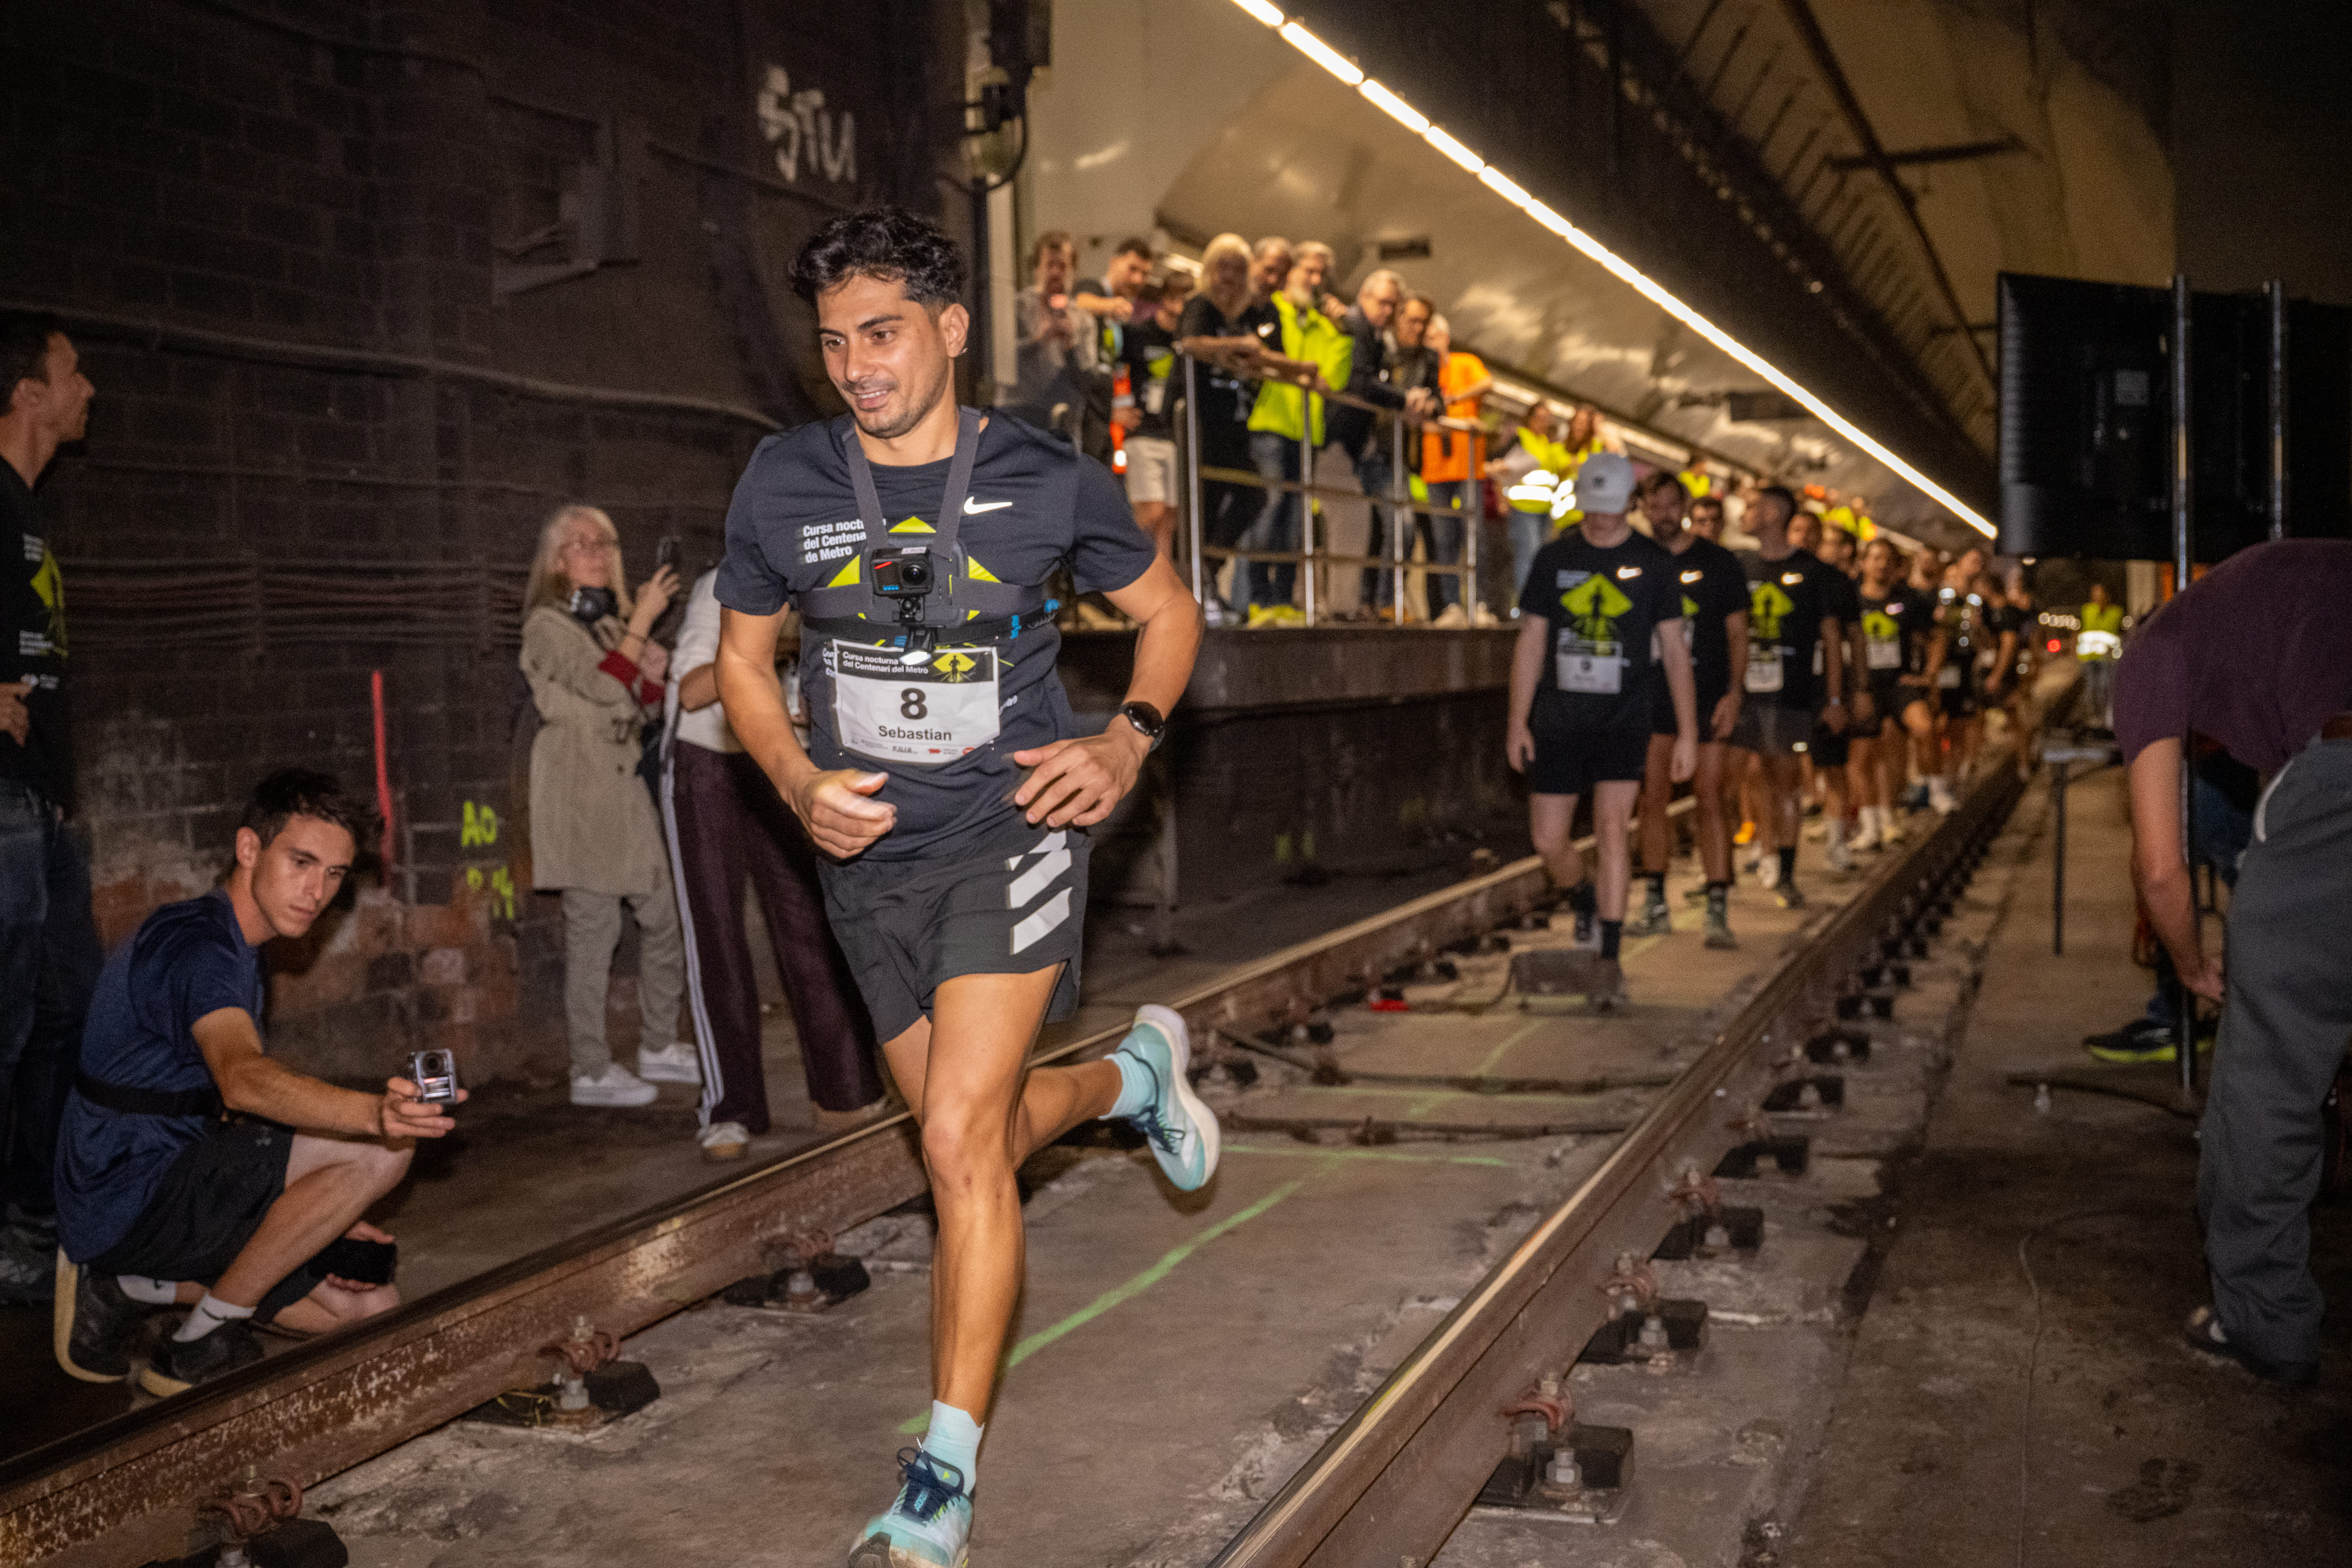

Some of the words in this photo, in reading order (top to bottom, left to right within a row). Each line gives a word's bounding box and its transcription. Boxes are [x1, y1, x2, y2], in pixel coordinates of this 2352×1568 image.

[803, 523, 834, 537] Cursa
[803, 537, 820, 550] del
[821, 532, 867, 547] Centena
[805, 551, 818, 563] de
[819, 546, 853, 561] Metro
[843, 651, 863, 662] Cursa
[864, 656, 899, 665] nocturna
[843, 660, 854, 668] del
[854, 661, 891, 673] Centenari
[901, 687, 928, 720] 8
[879, 725, 952, 741] Sebastian
